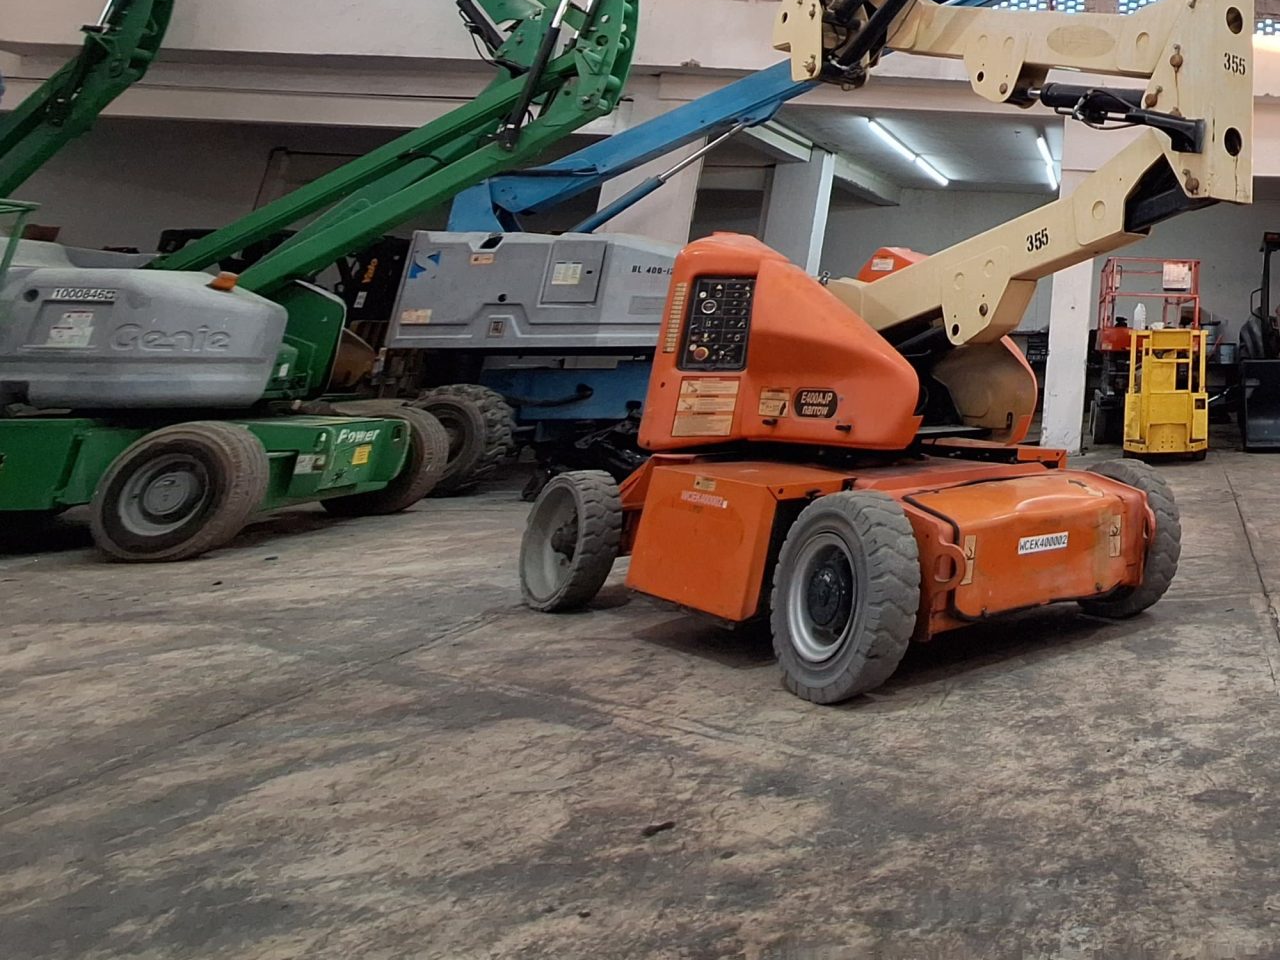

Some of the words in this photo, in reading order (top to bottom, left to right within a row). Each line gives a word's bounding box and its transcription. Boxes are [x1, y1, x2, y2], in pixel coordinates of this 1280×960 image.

[1223, 52, 1246, 75] 355
[1026, 227, 1049, 252] 355
[111, 323, 231, 353] Genie
[800, 392, 833, 405] E400AJP
[801, 405, 829, 416] narrow
[336, 429, 381, 444] Power
[1019, 534, 1068, 551] WCEK400002
